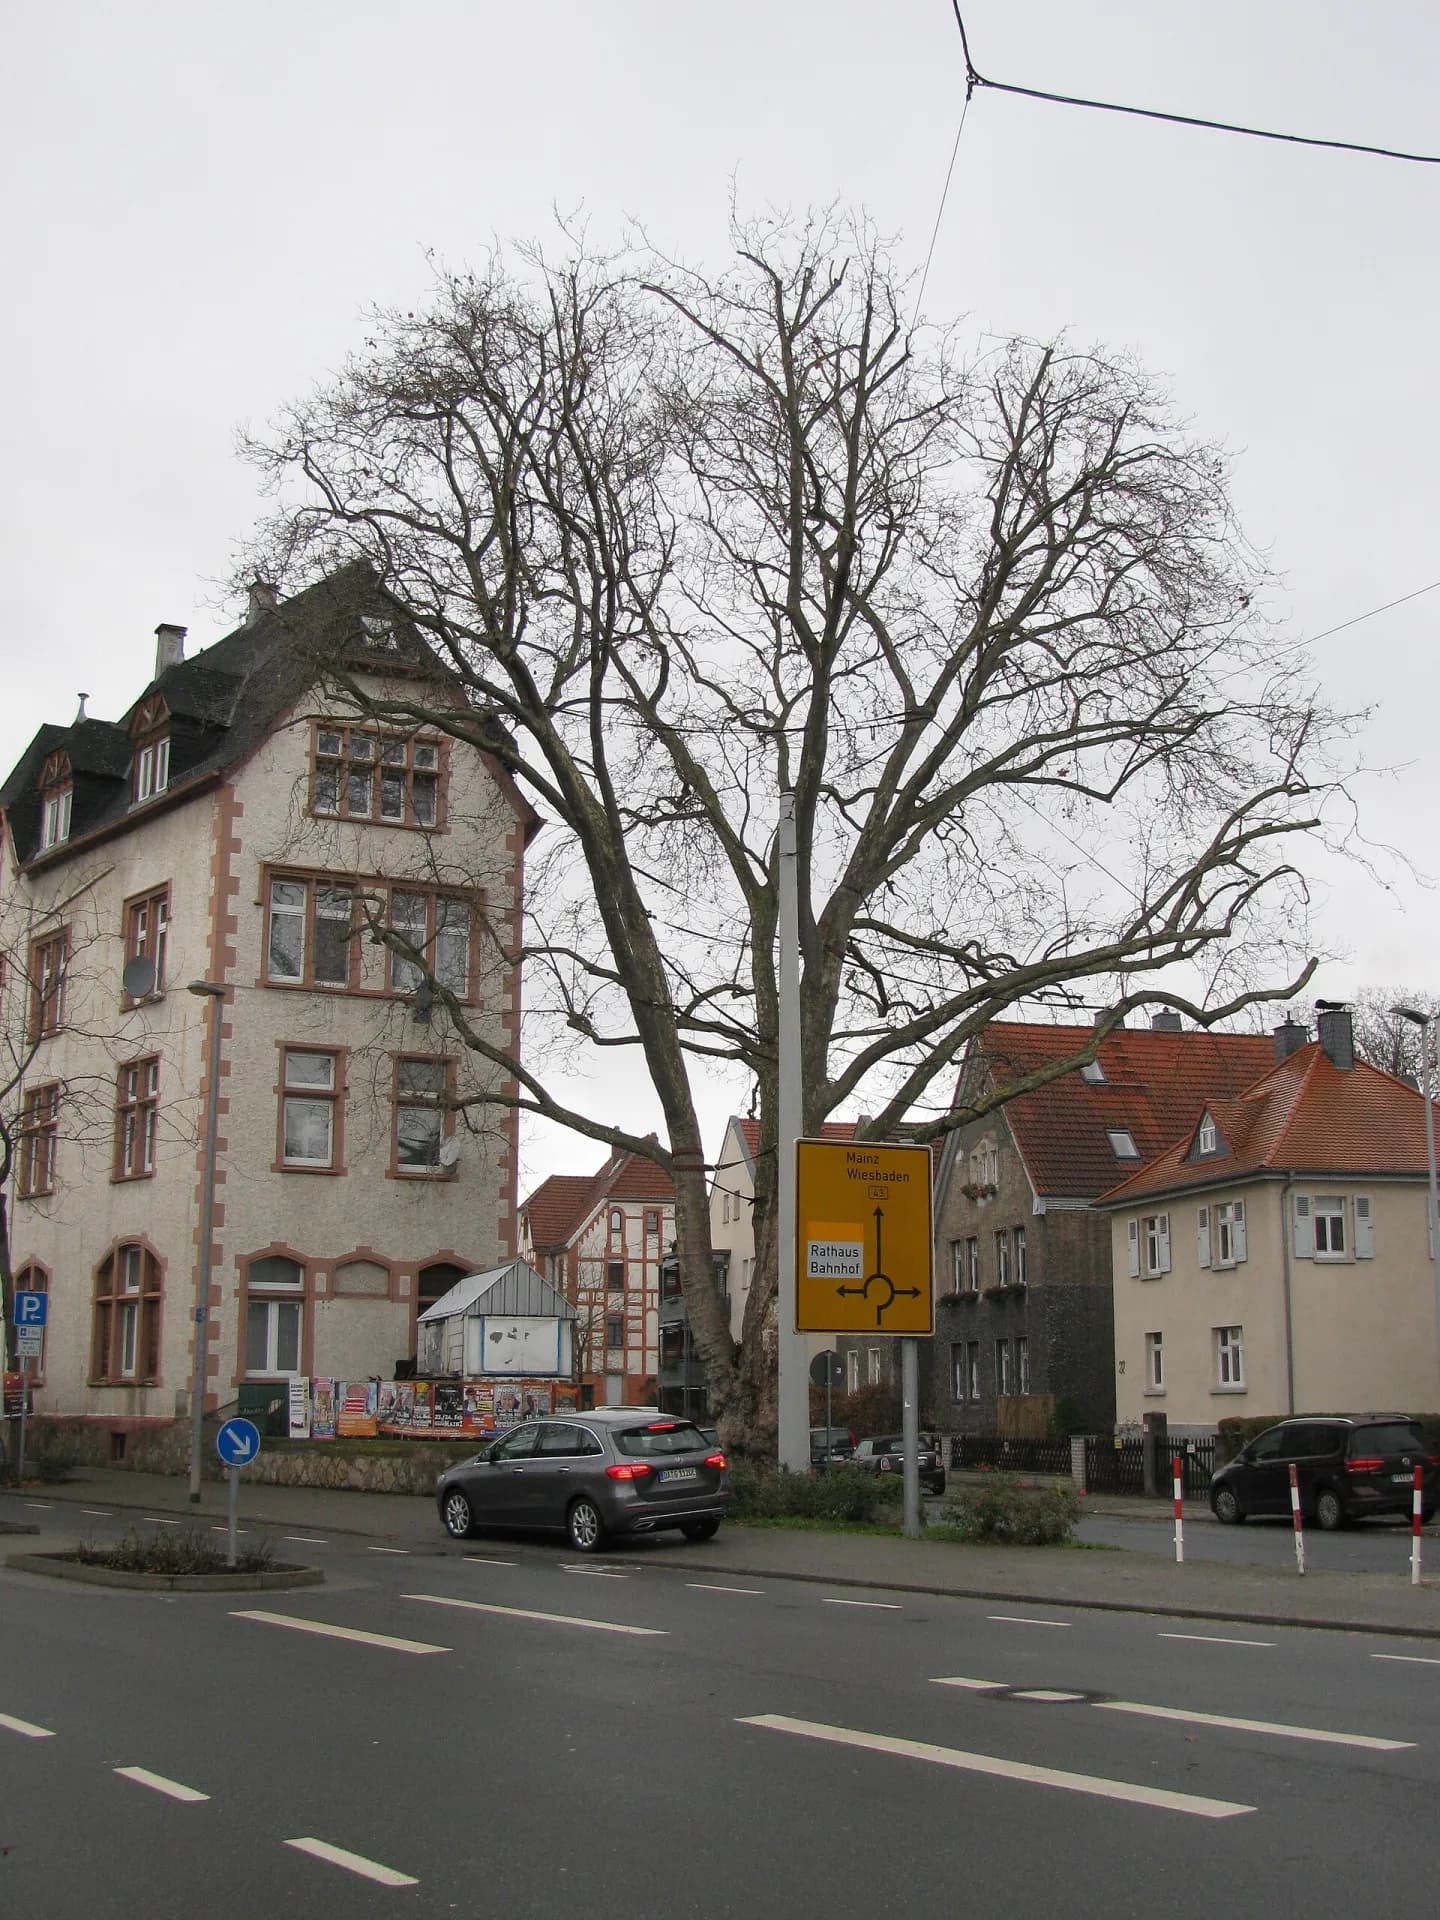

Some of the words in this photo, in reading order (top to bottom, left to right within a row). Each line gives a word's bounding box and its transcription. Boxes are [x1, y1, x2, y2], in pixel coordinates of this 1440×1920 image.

[847, 1151, 880, 1165] Mainz
[847, 1167, 910, 1182] Wiesbaden
[811, 1244, 859, 1258] Rathaus
[810, 1261, 860, 1274] Bahnhof
[21, 1295, 41, 1321] P
